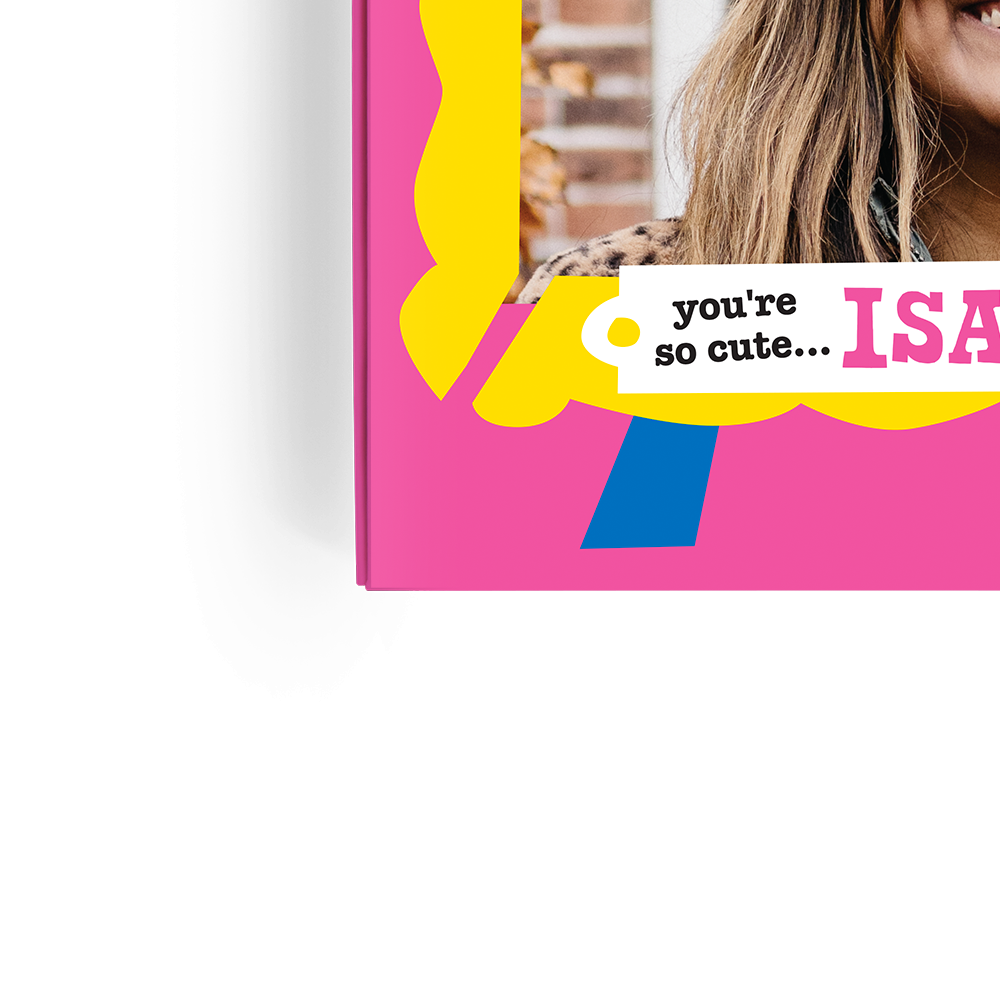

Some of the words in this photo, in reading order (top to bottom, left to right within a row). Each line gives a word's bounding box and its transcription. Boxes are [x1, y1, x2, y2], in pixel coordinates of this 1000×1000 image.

[671, 291, 798, 331] you're
[654, 342, 698, 367] so
[707, 331, 831, 363] cute...
